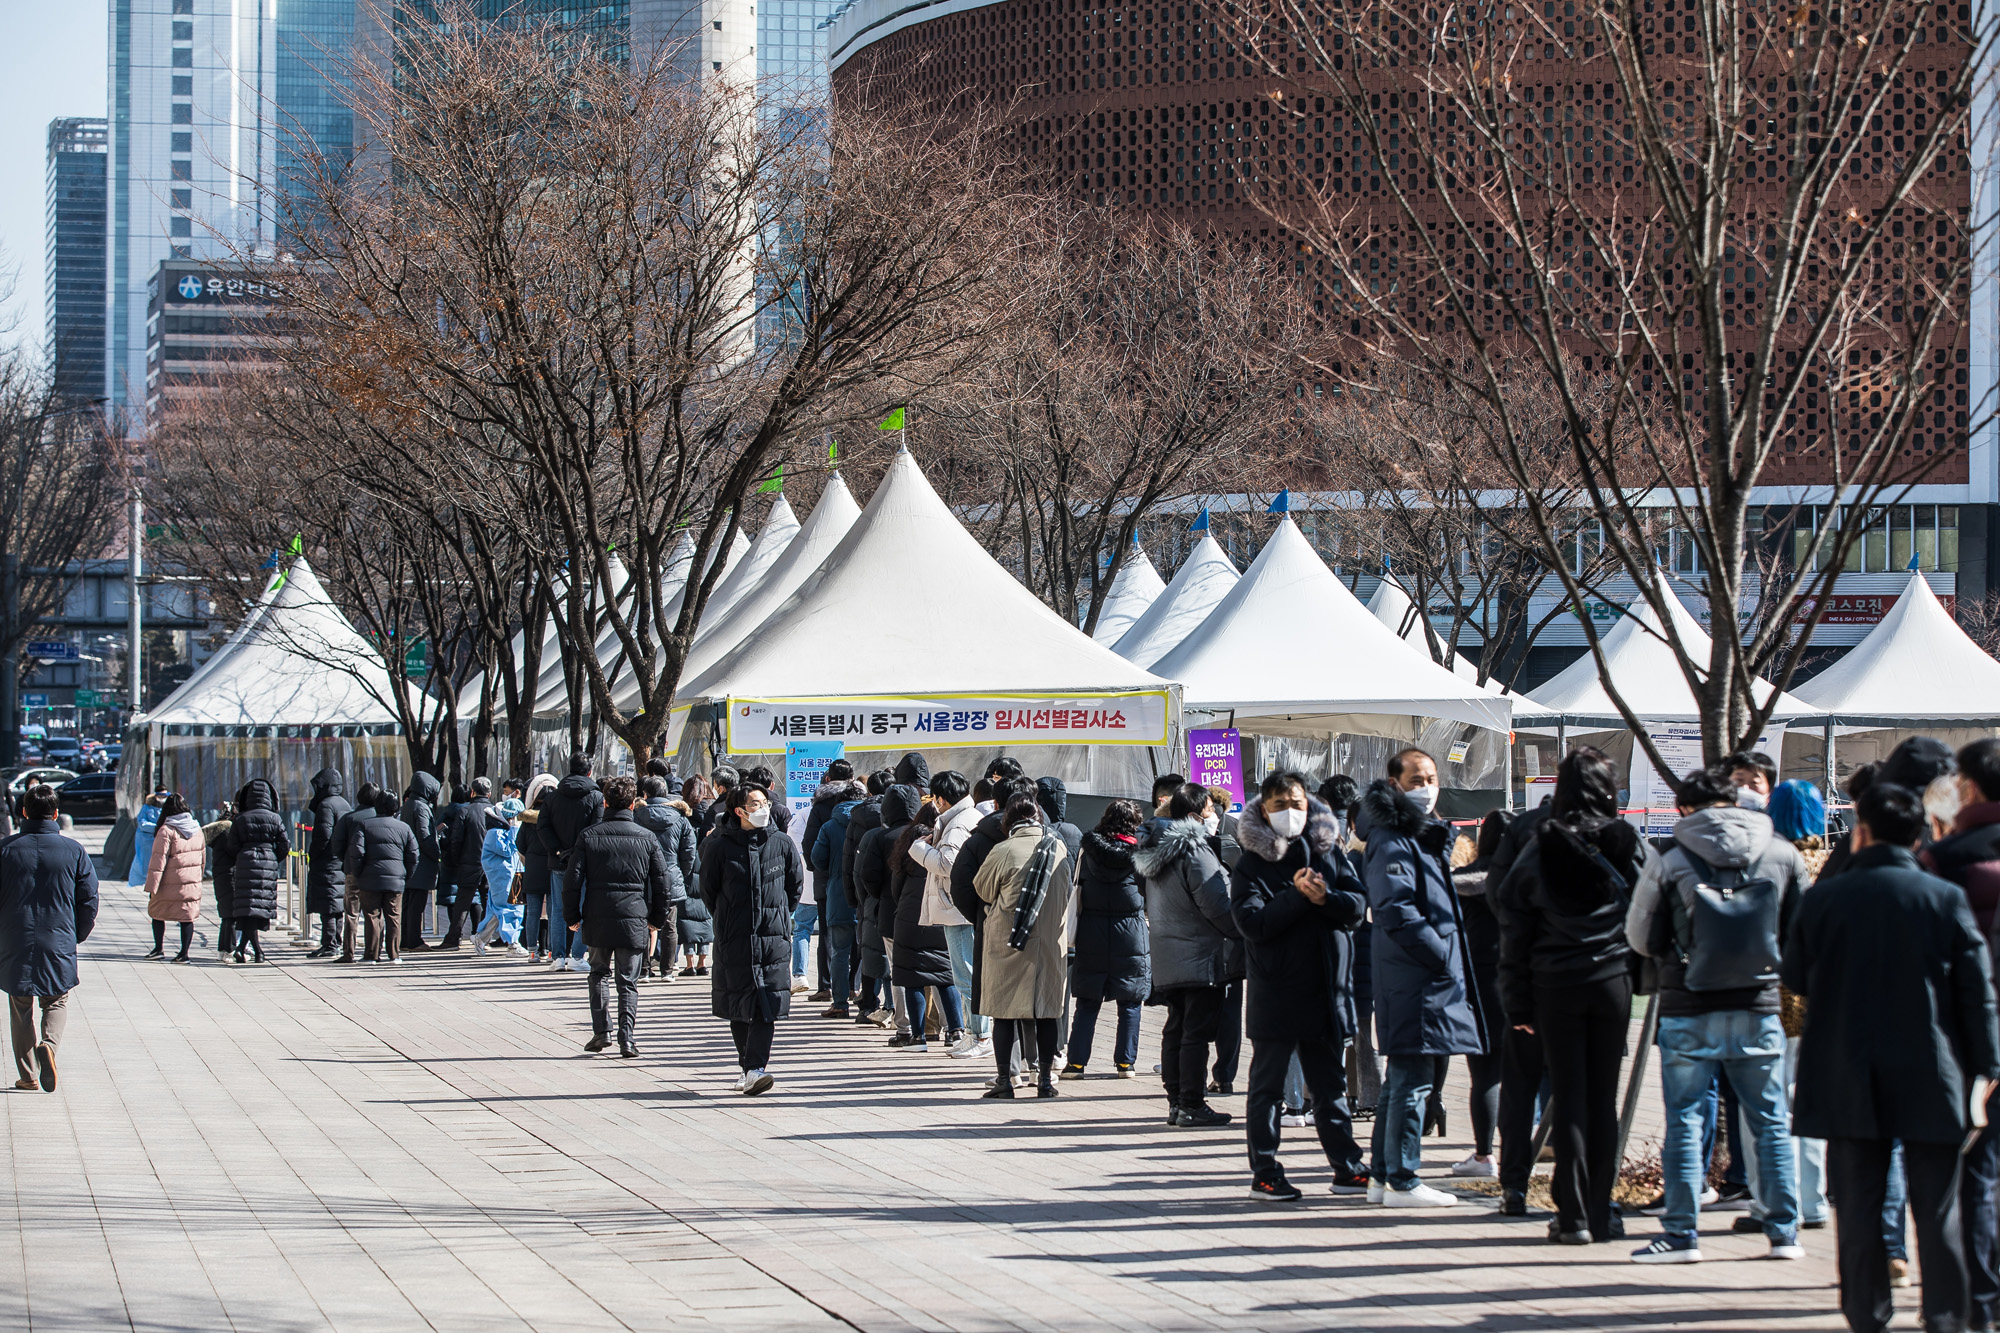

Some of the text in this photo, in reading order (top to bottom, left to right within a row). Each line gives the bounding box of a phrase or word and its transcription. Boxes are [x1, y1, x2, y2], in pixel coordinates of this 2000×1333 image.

[1824, 598, 1882, 615] 코스모진
[770, 709, 1127, 737] 서울특별시 중구 서울광장 임시선별검사소
[1195, 743, 1235, 758] 유전자검사
[799, 758, 833, 768] 서울 광장
[1204, 759, 1227, 770] (PCR)
[1201, 771, 1232, 786] 대상자
[800, 783, 816, 793] 운영
